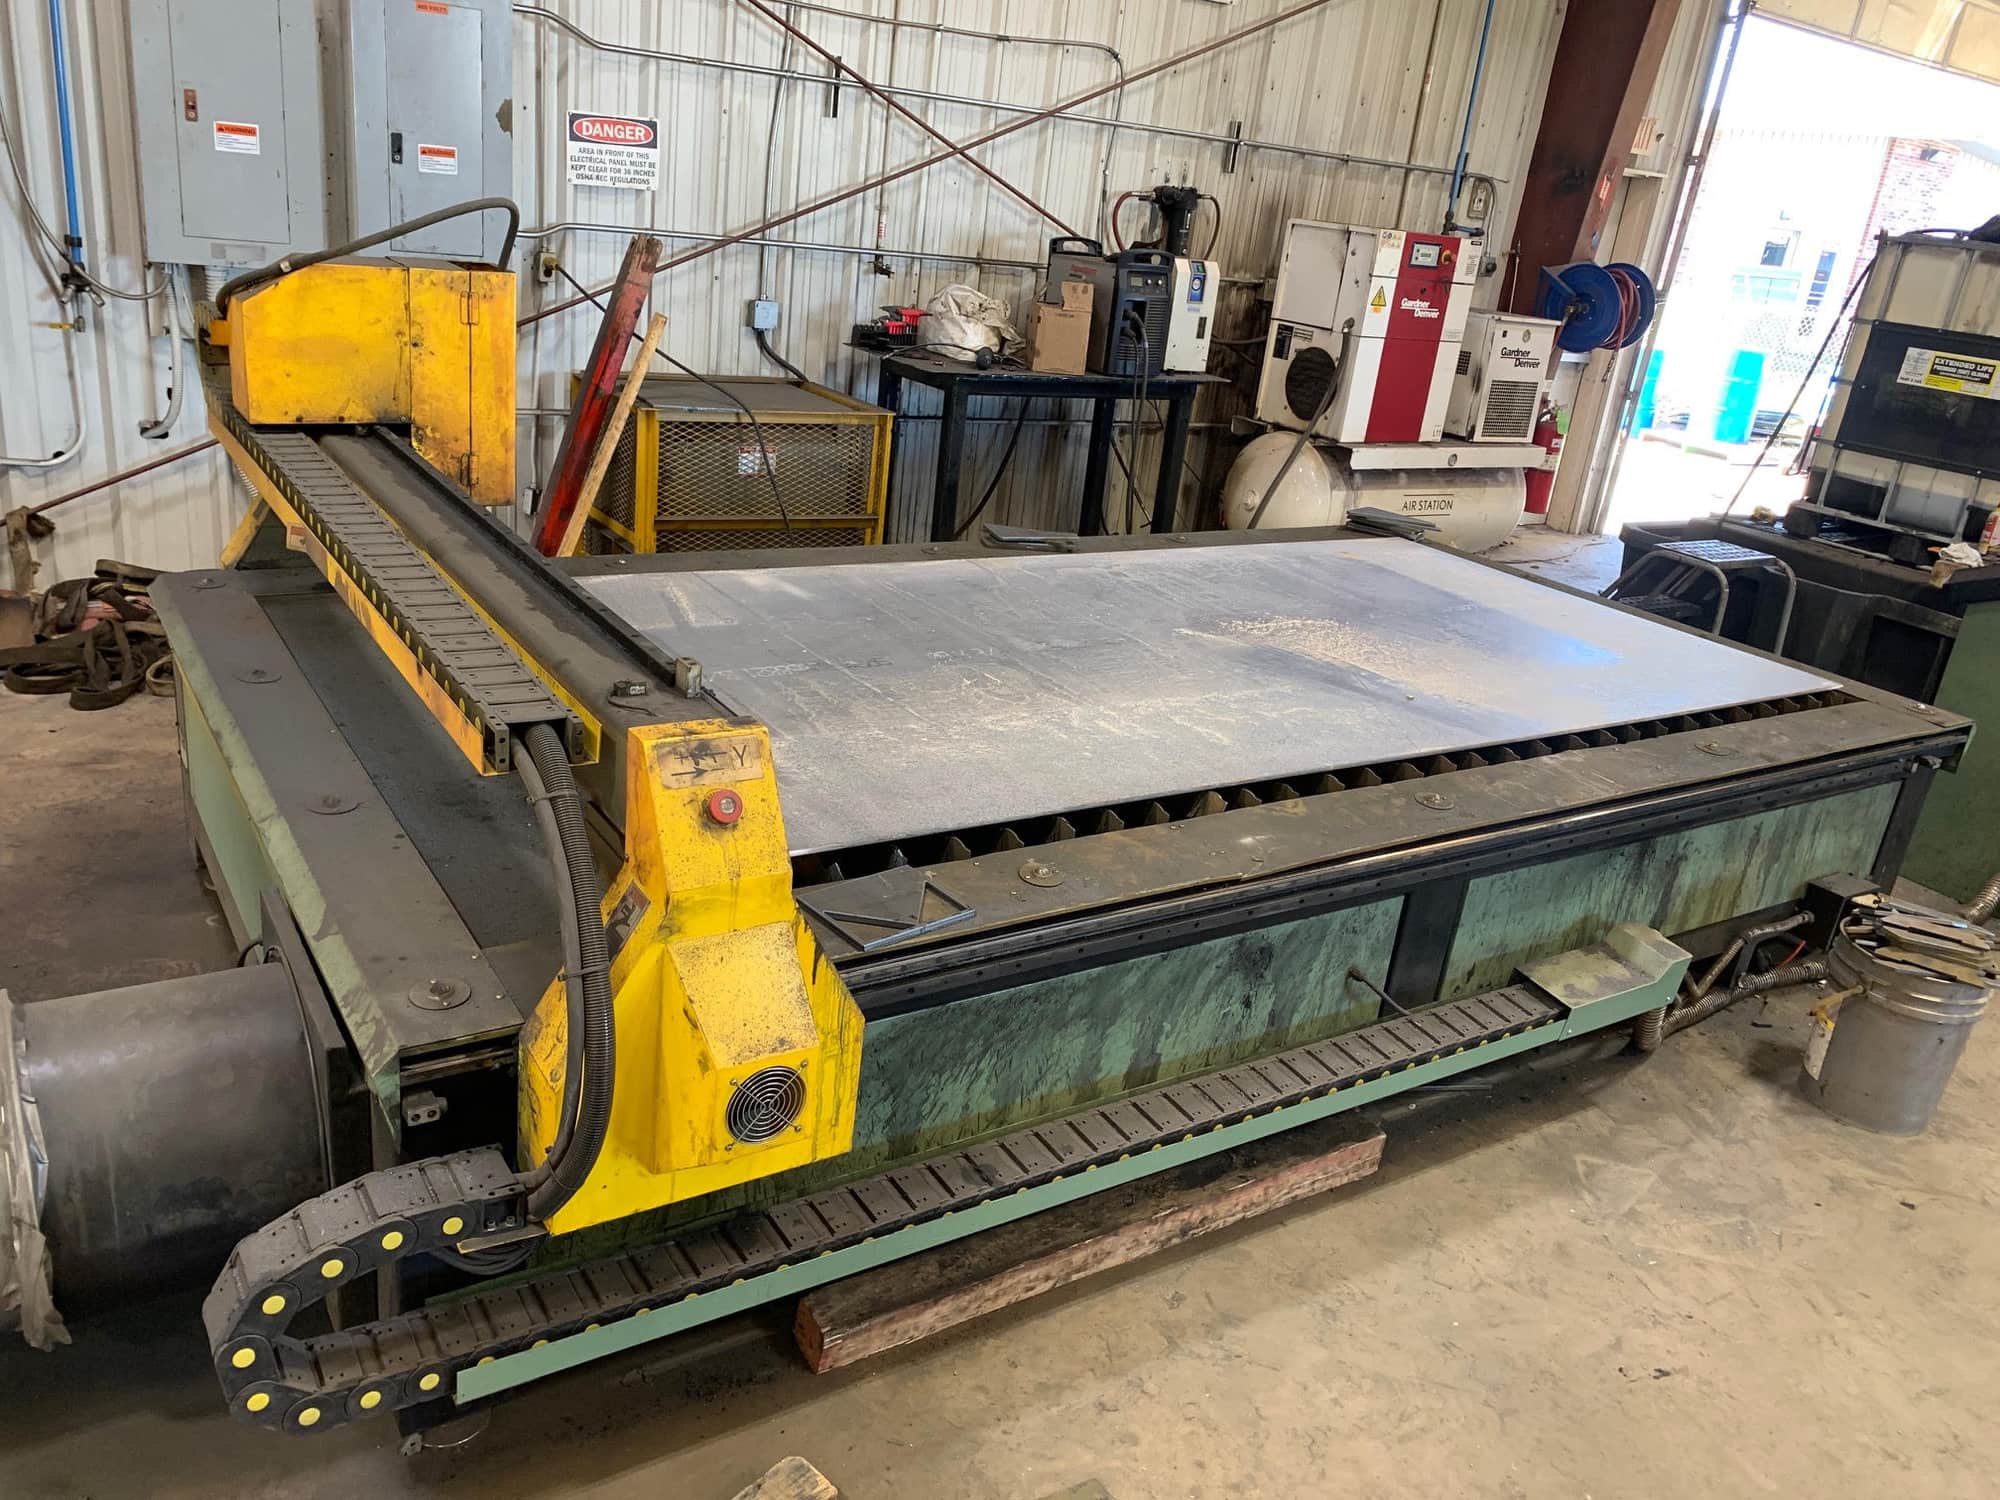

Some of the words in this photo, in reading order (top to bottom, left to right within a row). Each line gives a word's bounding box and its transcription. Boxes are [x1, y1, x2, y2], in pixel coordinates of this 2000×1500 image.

[582, 121, 645, 140] DANGER
[578, 147, 595, 155] AREA
[597, 148, 603, 156] IN
[605, 149, 624, 158] FRONT
[636, 152, 650, 160] THIS
[570, 155, 607, 165] ELECTRICAL
[609, 158, 627, 167] PANEL
[629, 160, 647, 168] MUST
[648, 161, 656, 169] BE
[571, 164, 586, 172] KEPT
[588, 165, 608, 173] CLEAR
[609, 166, 622, 174] FOR
[633, 168, 656, 178] INCHES
[609, 176, 650, 184] REGULATIONS
[1401, 297, 1430, 308] Gardner
[1414, 309, 1440, 319] Denver
[1501, 346, 1531, 357] Gardner
[1514, 358, 1540, 369] Denver
[1934, 357, 1976, 370] EXTENDED
[1401, 500, 1417, 511] AIR
[1418, 499, 1454, 511] STATION
